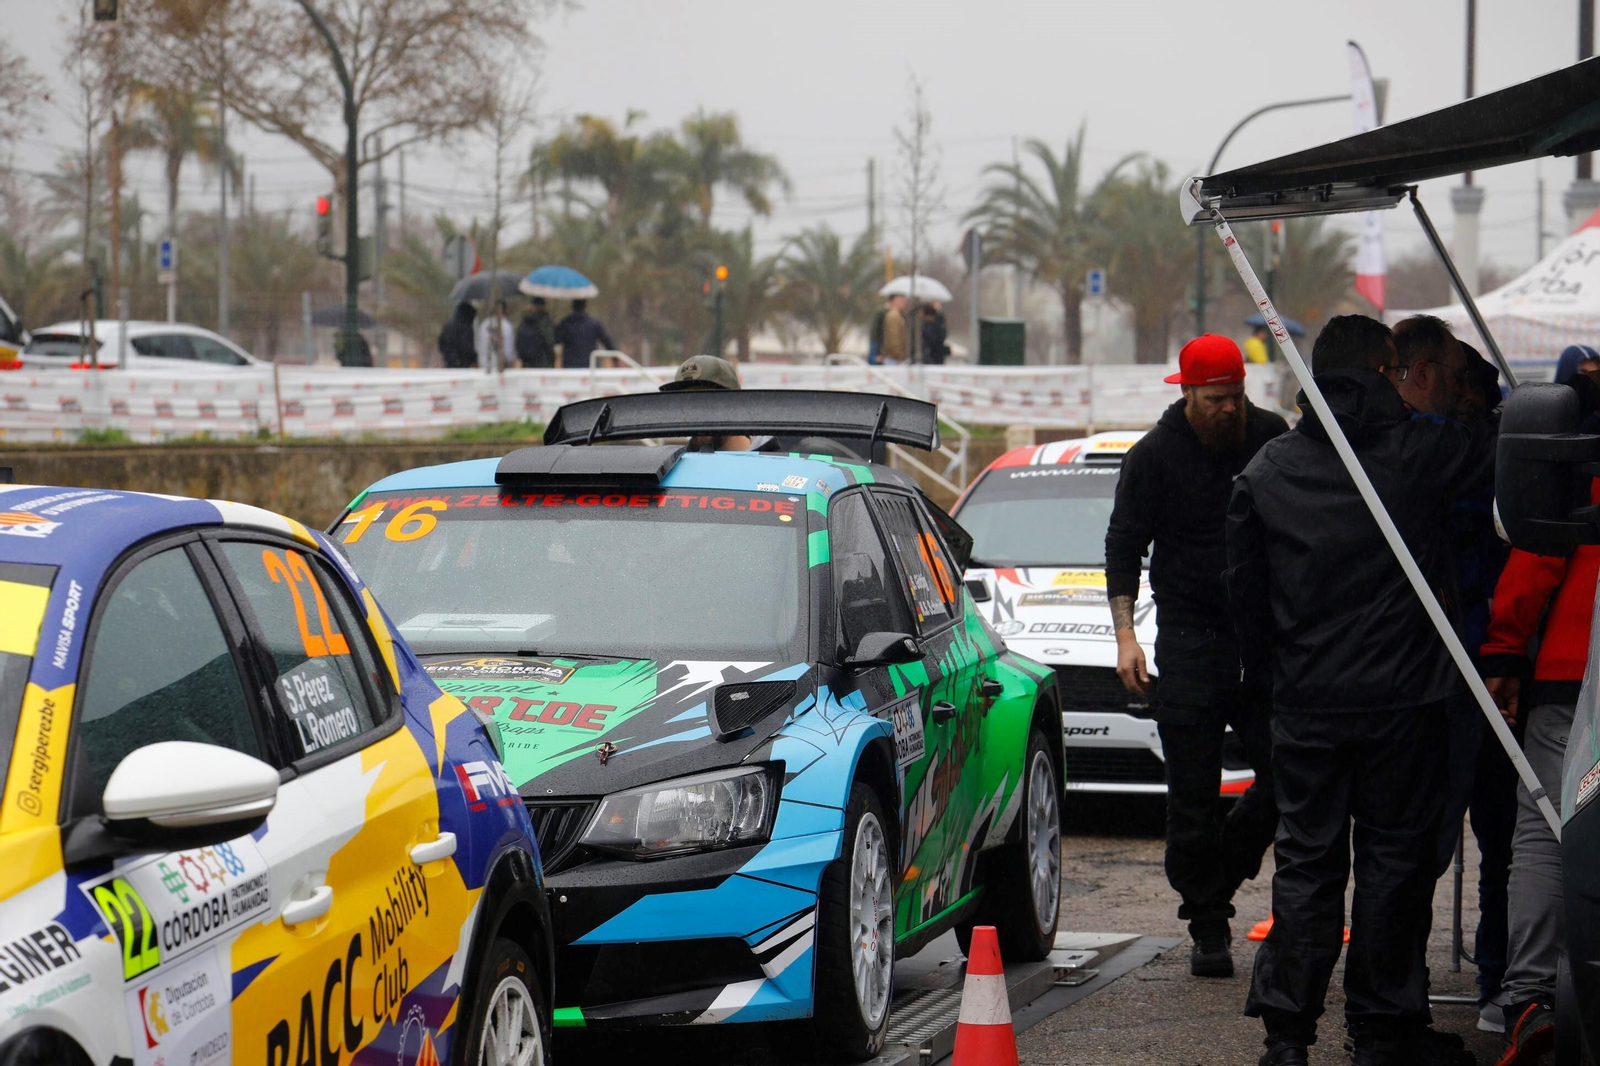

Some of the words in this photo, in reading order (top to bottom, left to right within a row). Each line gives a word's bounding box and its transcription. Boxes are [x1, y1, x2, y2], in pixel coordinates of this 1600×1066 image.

[342, 499, 448, 544] 16
[917, 531, 954, 605] 16
[59, 579, 84, 631] SPORT
[262, 549, 351, 658] 22
[1028, 622, 1116, 636] SETRA
[281, 671, 335, 715] S.Pérez
[29, 698, 56, 794] sergiperezbe
[294, 706, 357, 754] L.Romero
[94, 877, 161, 980] 22
[162, 893, 230, 952] CÓRDOBA
[369, 864, 429, 966] Mobility
[373, 947, 409, 1024] Club
